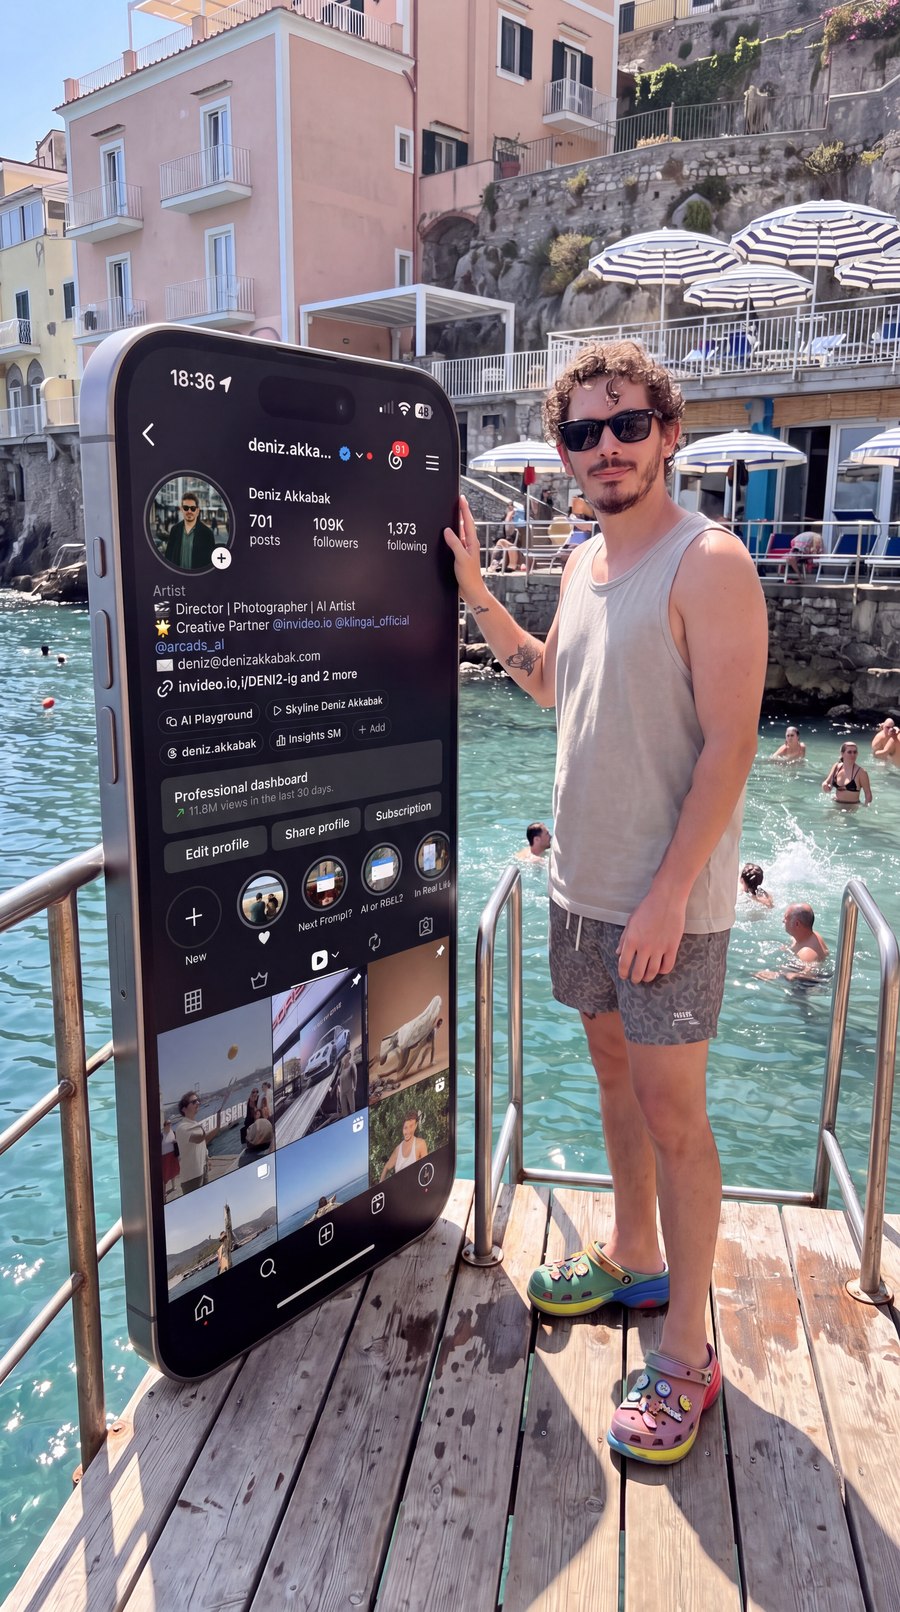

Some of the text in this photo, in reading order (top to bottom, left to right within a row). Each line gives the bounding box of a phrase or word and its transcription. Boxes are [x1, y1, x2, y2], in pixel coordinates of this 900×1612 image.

[170, 369, 215, 391] 18:36
[248, 437, 332, 459] deniz.akka...
[395, 444, 406, 455] 91
[248, 487, 331, 505] Deniz Akkabak
[249, 514, 273, 528] 701
[313, 517, 344, 532] 109K
[387, 522, 417, 537] 1,373
[250, 534, 281, 548] posts
[312, 535, 359, 549] followers
[386, 539, 428, 554] following
[153, 584, 186, 597] Artist
[176, 602, 224, 615] Director
[233, 601, 308, 616] Photographer
[316, 601, 327, 612] AI
[329, 600, 356, 611] Artist
[176, 615, 410, 634] Creative Partner @invideo.io @klingai_official
[177, 652, 321, 670] deniz@denizakkabak.com
[300, 670, 320, 683] and
[323, 670, 330, 681] 2
[332, 670, 358, 680] more
[285, 695, 383, 716] Skyline Deniz Akkabak
[180, 709, 253, 726] AI Playground
[289, 728, 342, 744] Insights SM
[370, 723, 386, 733] Add
[181, 738, 257, 758] deniz.akkabak
[174, 772, 308, 804] Professional dashboard
[188, 785, 334, 816] 11.8M views in the last 30 days.
[376, 802, 432, 821] Subscription
[285, 818, 350, 840] Share profile
[186, 838, 250, 860] Edit profile
[414, 889, 422, 898] In
[422, 883, 438, 896] Real
[361, 903, 369, 914] AI
[370, 902, 379, 911] or
[298, 919, 318, 932] Next
[185, 953, 207, 966] New
